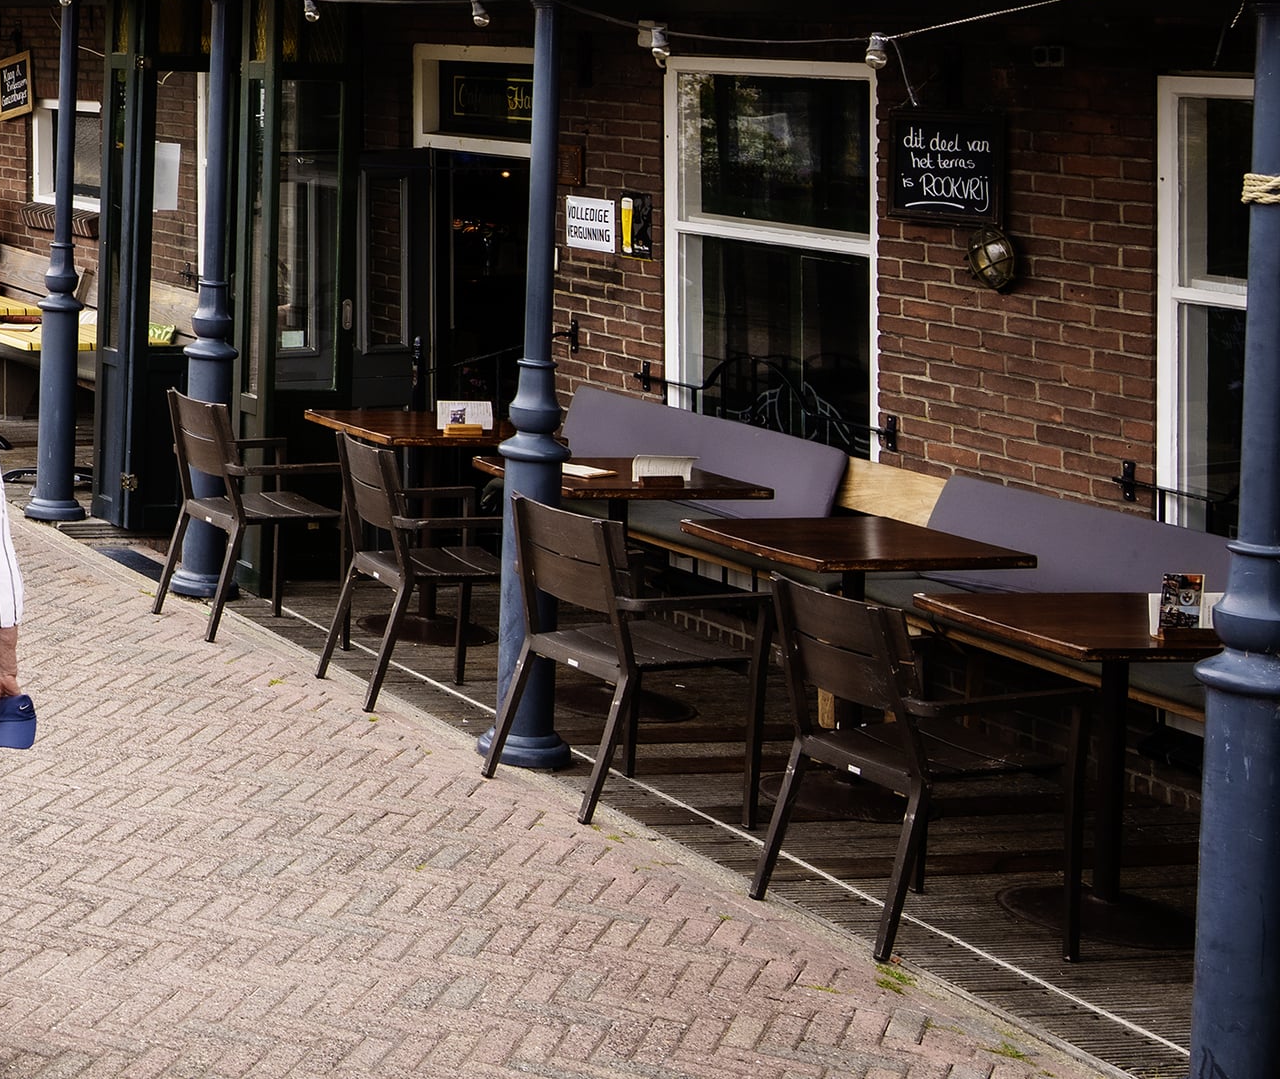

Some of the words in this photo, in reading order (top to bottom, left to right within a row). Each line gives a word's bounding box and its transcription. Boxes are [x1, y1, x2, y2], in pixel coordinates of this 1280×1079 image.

[903, 126, 926, 149] dit
[929, 131, 962, 153] deel
[967, 140, 991, 153] van
[910, 152, 935, 169] het
[936, 153, 976, 170] terras
[900, 172, 915, 188] is
[567, 205, 610, 224] VOLLEDIGE
[567, 224, 611, 243] VERGUNNING
